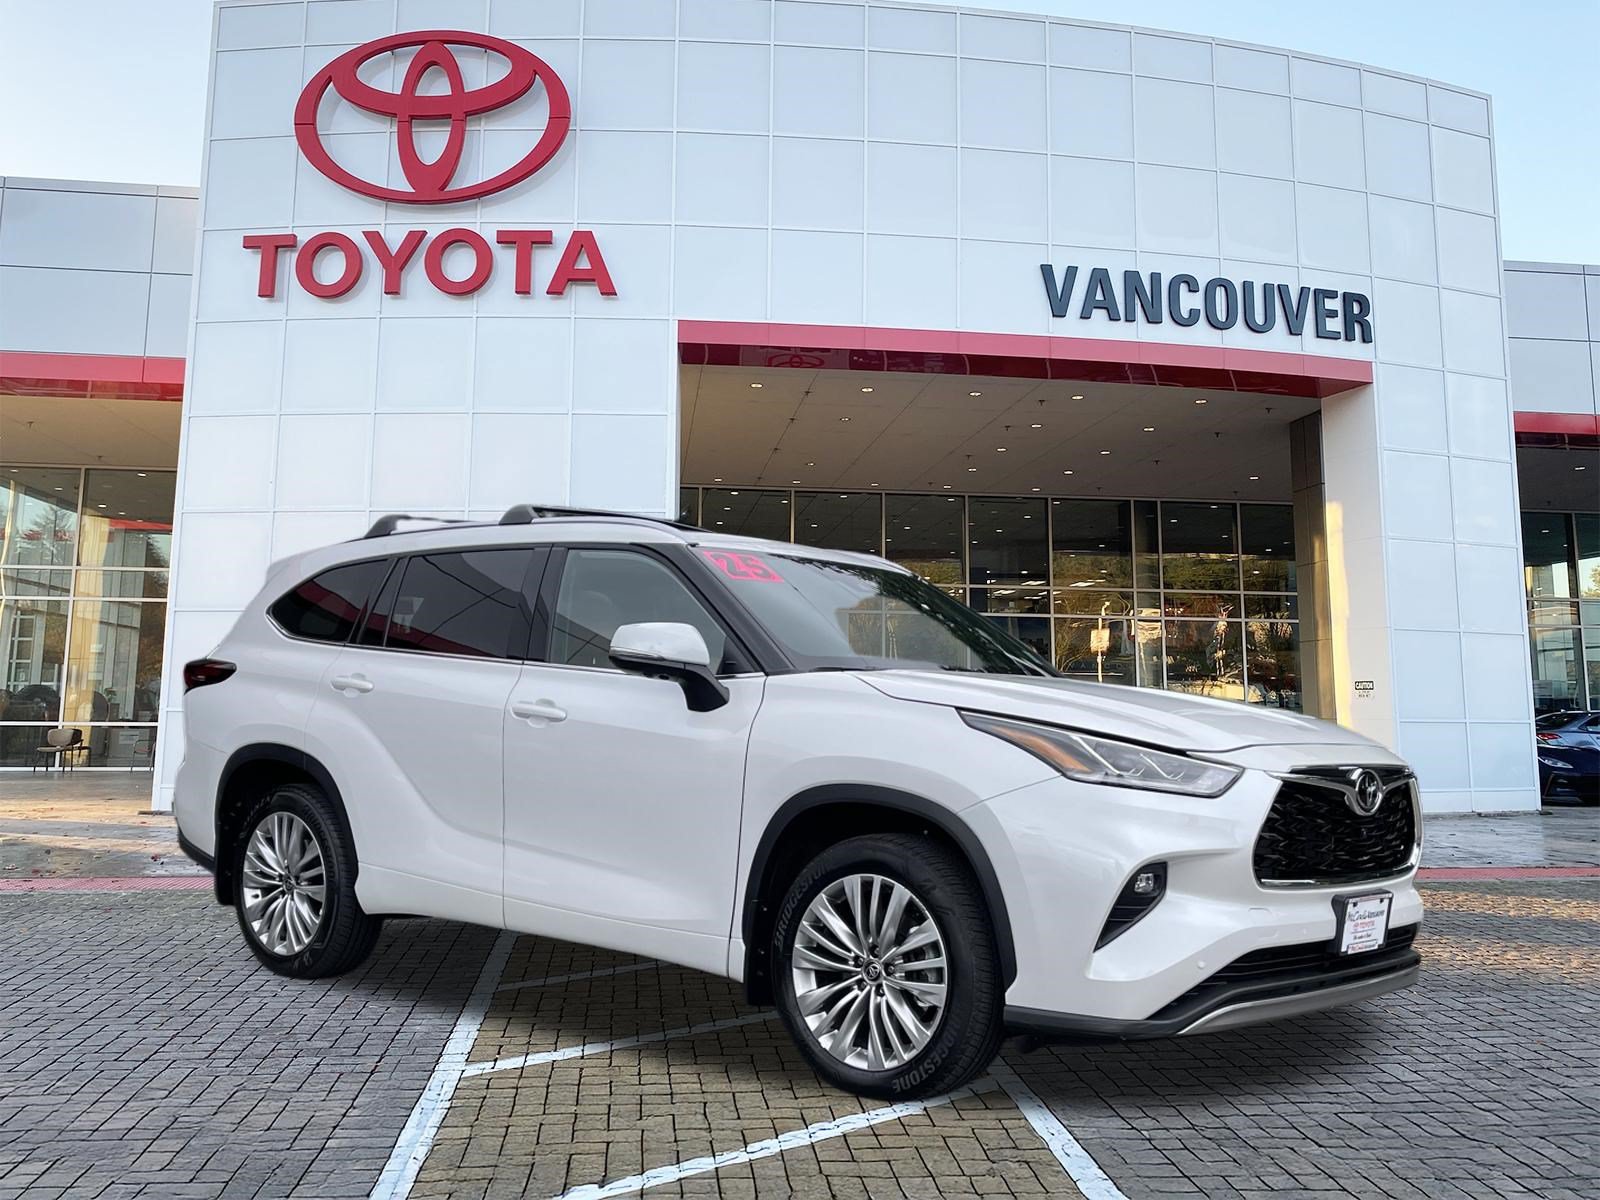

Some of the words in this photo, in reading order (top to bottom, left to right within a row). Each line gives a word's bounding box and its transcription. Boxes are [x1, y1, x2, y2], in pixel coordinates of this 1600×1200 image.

[243, 228, 618, 298] TOYOTA
[1040, 264, 1373, 343] VANCOUVER
[710, 552, 774, 579] 25
